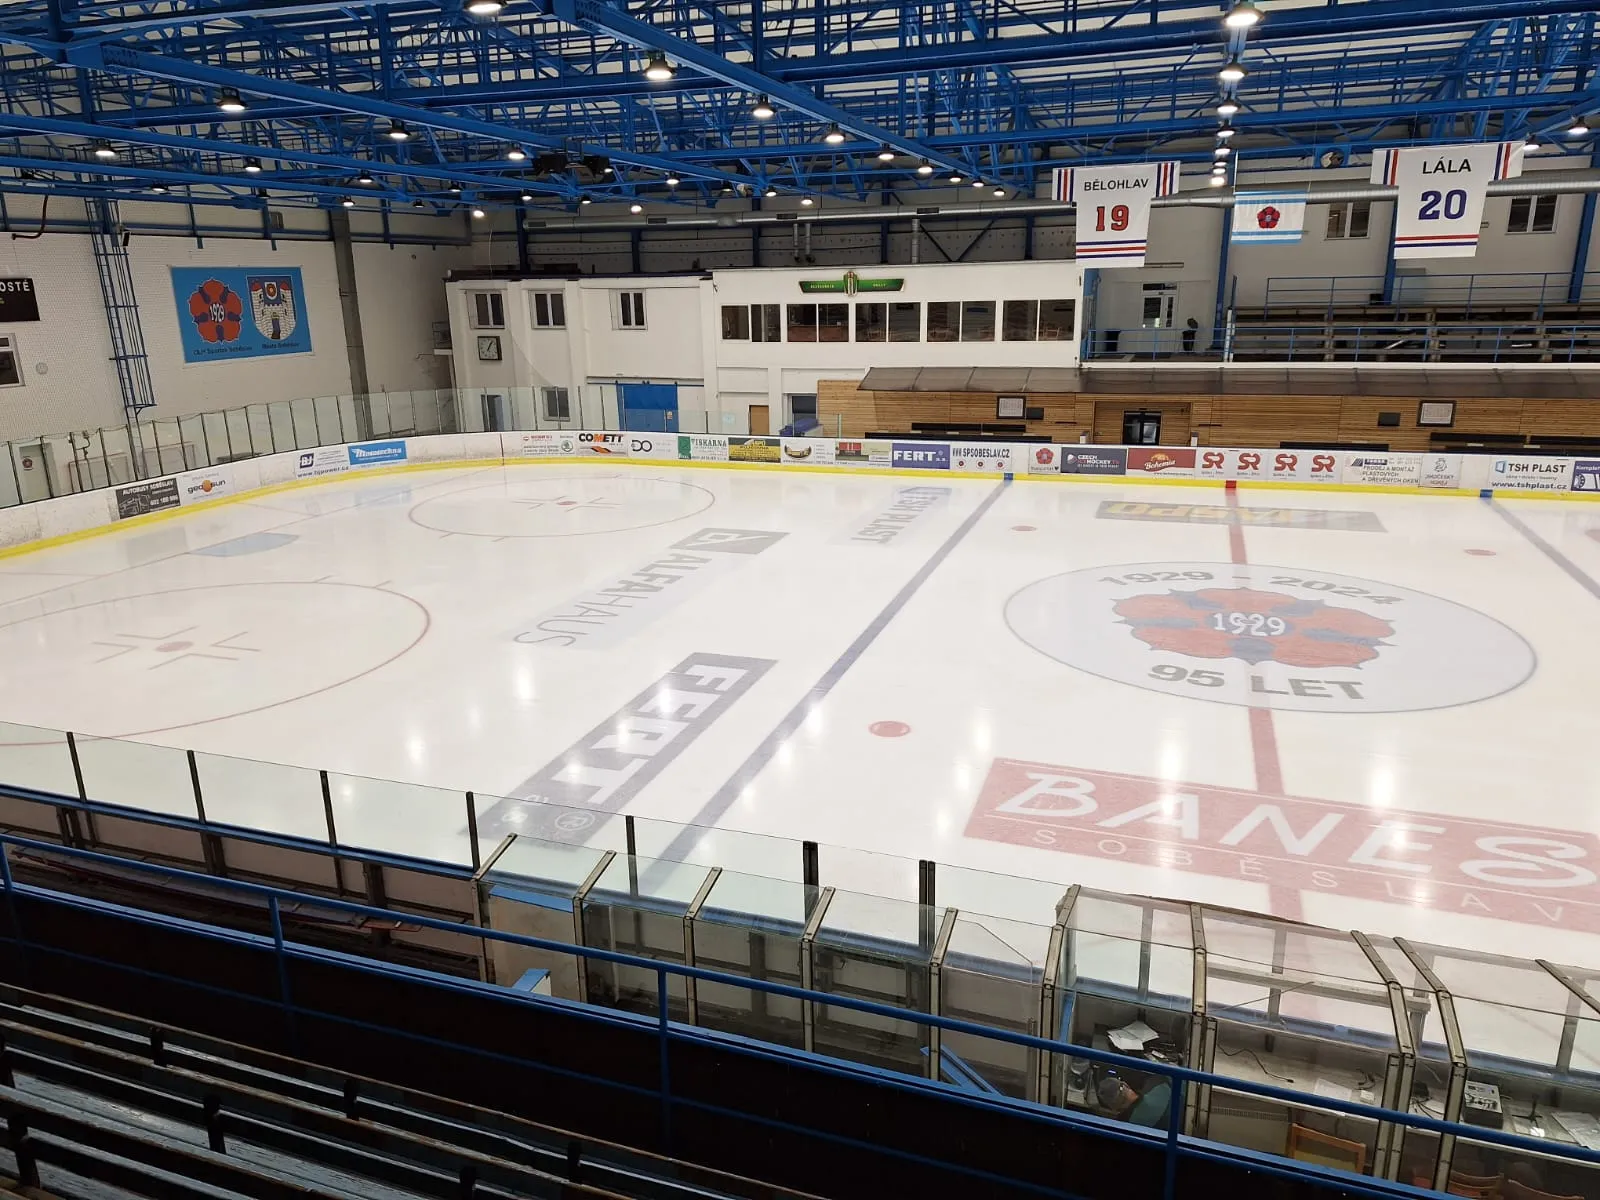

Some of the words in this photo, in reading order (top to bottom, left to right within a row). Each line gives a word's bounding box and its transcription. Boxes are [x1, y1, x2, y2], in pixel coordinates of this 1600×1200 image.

[1422, 157, 1472, 175] LÁLA
[1083, 178, 1149, 192] BĚLOHLAV
[1418, 189, 1467, 221] 20
[1095, 204, 1129, 232] 19
[209, 303, 226, 323] 1929
[579, 433, 624, 443] COMETT
[893, 450, 936, 462] FERT
[1144, 459, 1176, 470] Bohemia
[1201, 451, 1225, 469] SR
[1237, 452, 1261, 470] SR
[1274, 453, 1298, 471] SR
[1311, 454, 1335, 473] SR
[1508, 463, 1530, 472] TSH
[1532, 463, 1567, 473] PLAST
[1492, 481, 1567, 490] www.tshplast.cz
[1099, 570, 1215, 587] 1929
[1268, 575, 1404, 606] 2024
[513, 552, 713, 647] ALFAHAUS
[1211, 611, 1286, 637] 1929
[1146, 663, 1226, 689] 95
[1250, 674, 1365, 700] LET
[551, 664, 749, 804] FERT
[995, 771, 1597, 888] BANES
